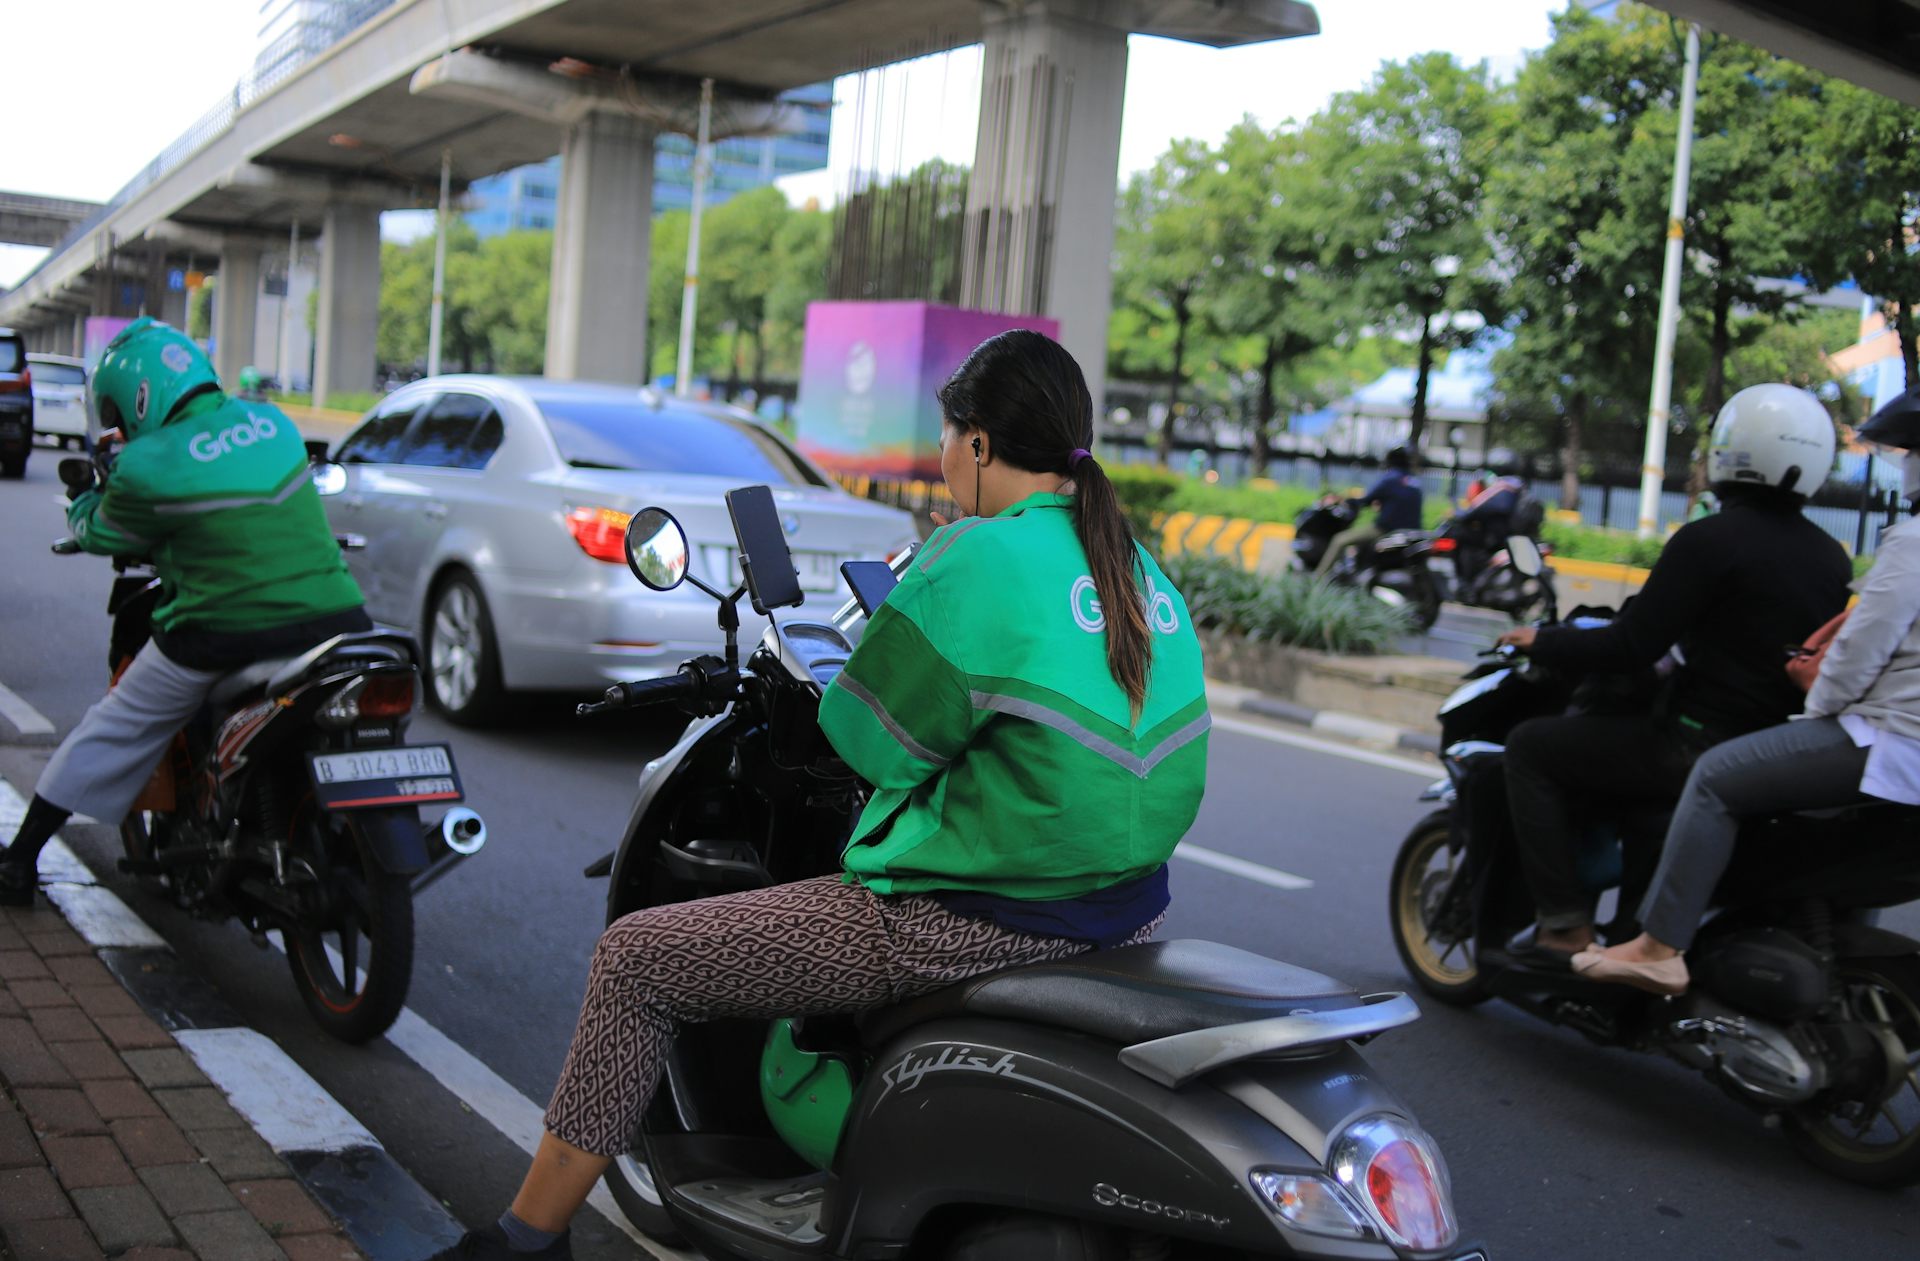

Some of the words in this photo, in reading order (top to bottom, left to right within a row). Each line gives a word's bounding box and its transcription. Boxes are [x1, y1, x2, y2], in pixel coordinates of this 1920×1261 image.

[189, 411, 277, 462] Grab
[1070, 575, 1178, 634] Gb
[869, 1047, 1016, 1118] Stylish
[1322, 1073, 1369, 1089] HONDA
